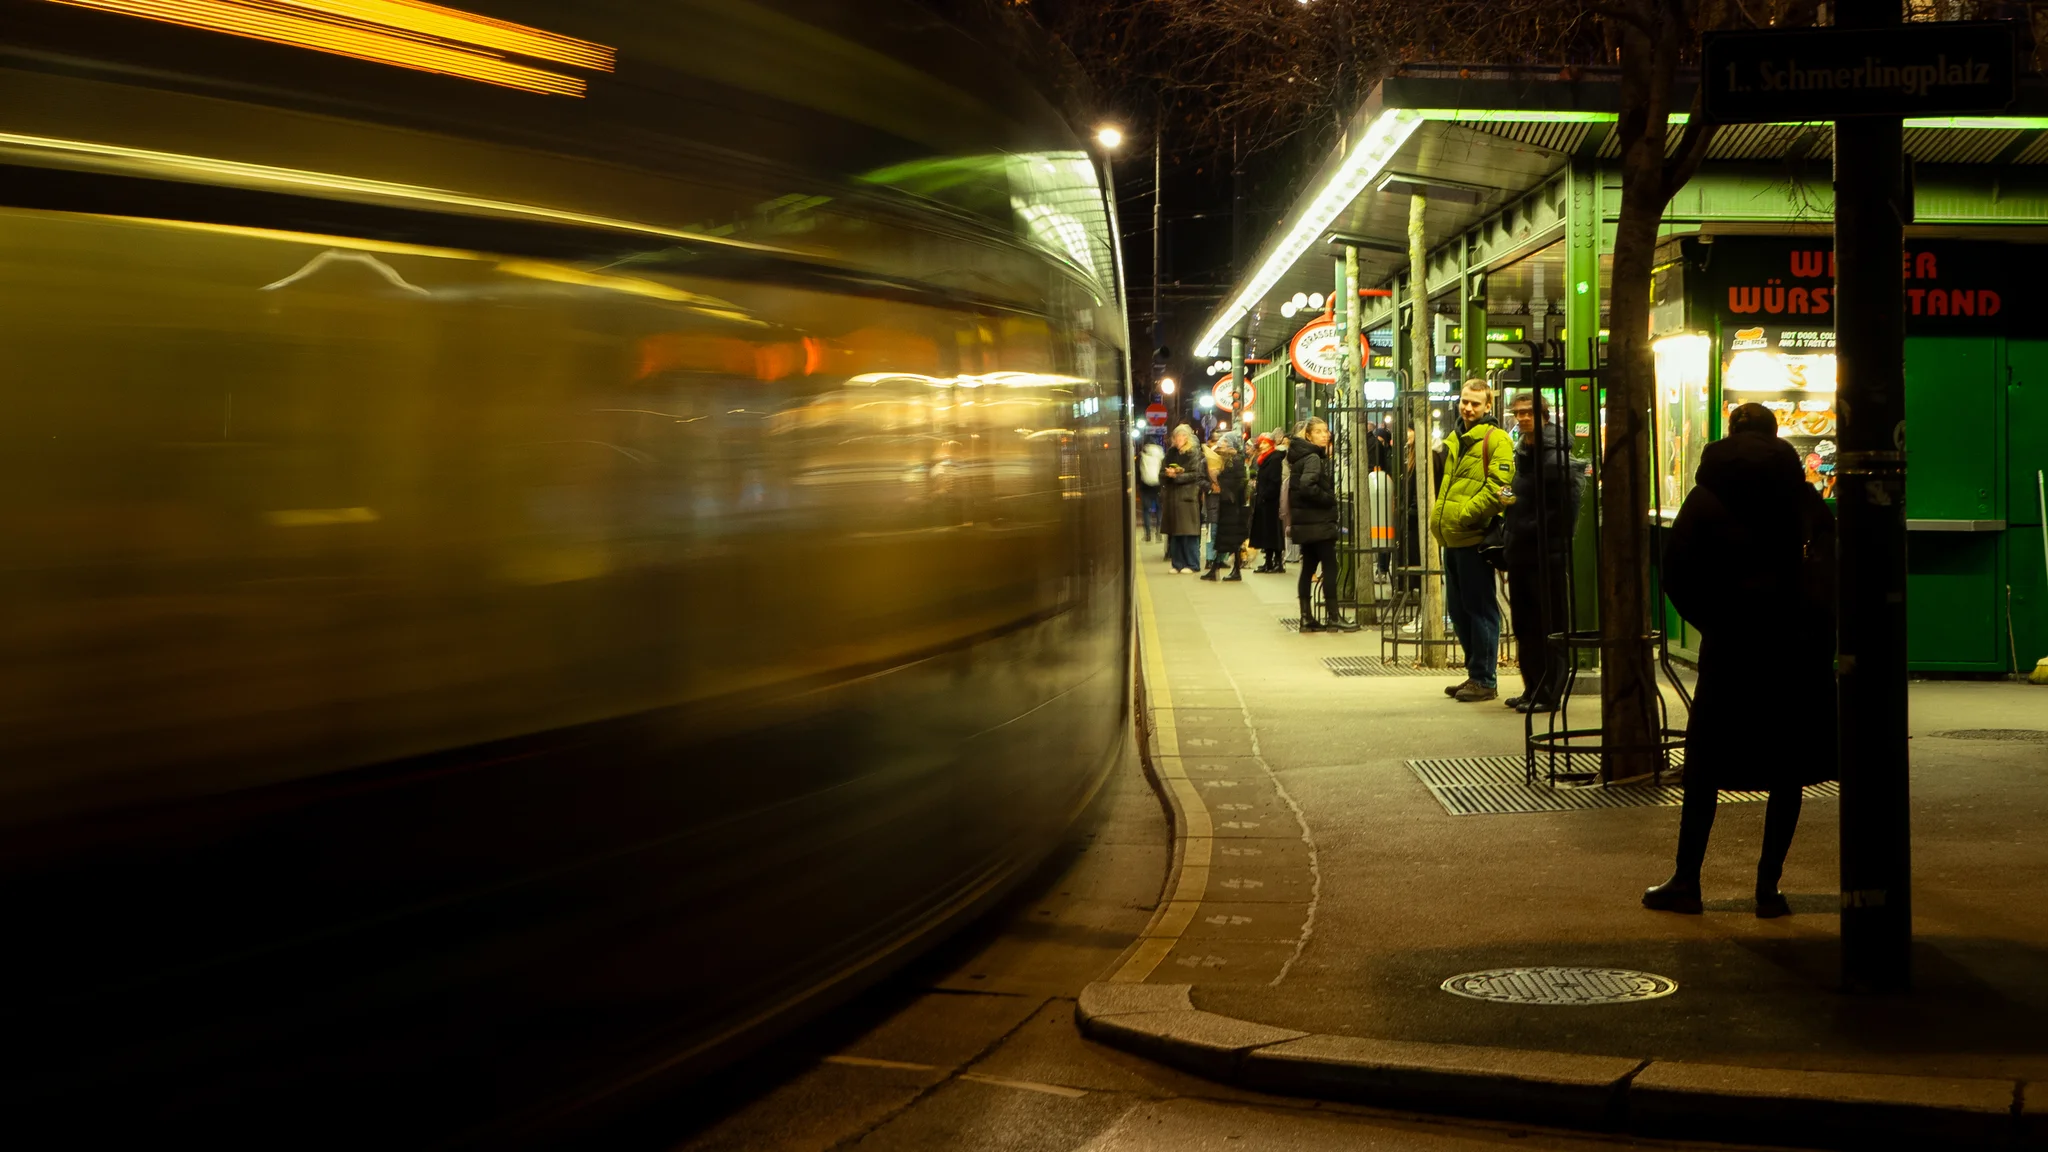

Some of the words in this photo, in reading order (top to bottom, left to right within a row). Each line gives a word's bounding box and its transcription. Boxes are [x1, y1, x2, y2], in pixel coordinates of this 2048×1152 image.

[1759, 52, 1991, 97] Schmerlingplatz
[1728, 278, 2002, 316] WÜRSTAND
[1301, 328, 1337, 350] STRASSE
